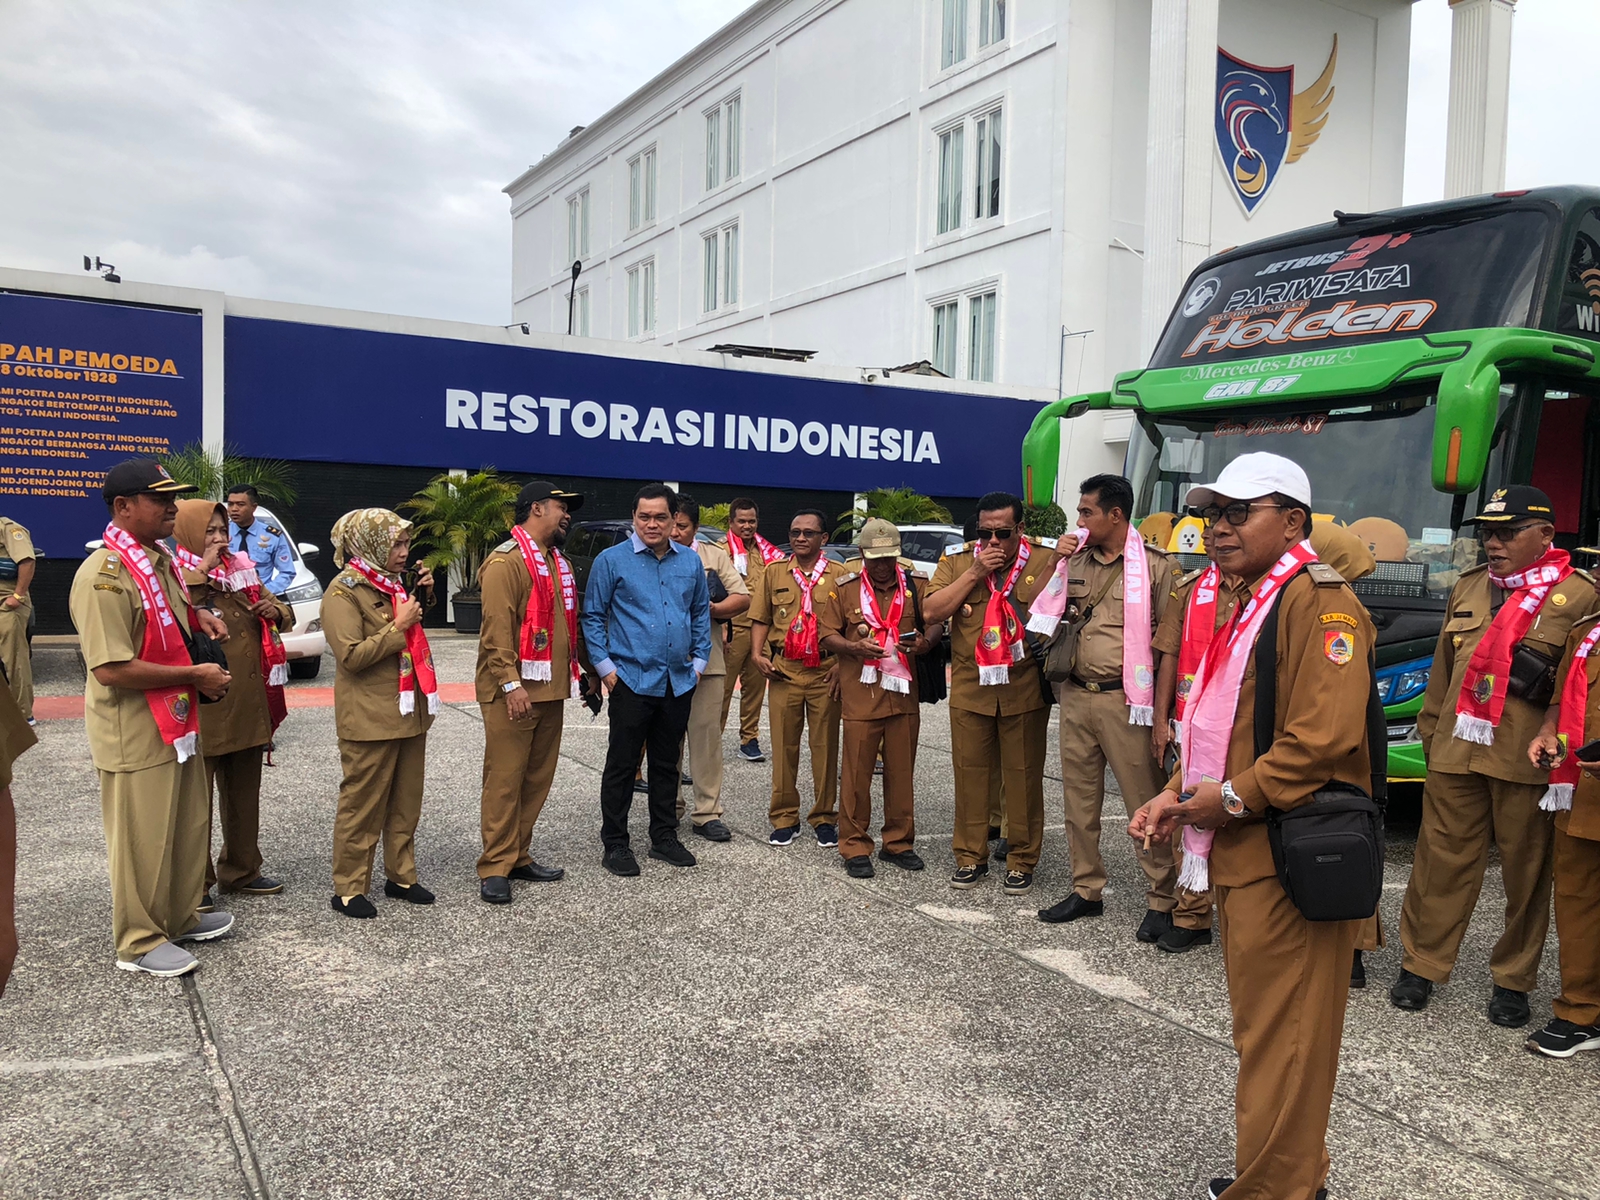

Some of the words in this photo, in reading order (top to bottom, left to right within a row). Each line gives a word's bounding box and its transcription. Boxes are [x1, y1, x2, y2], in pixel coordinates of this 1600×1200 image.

[1255, 250, 1345, 277] JETBUS
[1223, 264, 1410, 313] PARIWISATA
[1181, 299, 1438, 359] Holden
[59, 348, 178, 375] PEMOEDA
[14, 365, 81, 380] Oktober
[84, 370, 118, 384] 1928
[1257, 373, 1303, 395] 87
[0, 387, 14, 395] MI
[15, 388, 56, 398] POETRA
[57, 391, 80, 400] DAN
[81, 393, 116, 403] POETRI
[117, 396, 173, 409] INDONESIA,
[0, 397, 45, 407] NGAKOE
[46, 400, 113, 412] BERTOEMPAH
[115, 405, 149, 415] DARAH
[151, 408, 178, 418] JANG
[25, 408, 61, 418] TANAH
[62, 411, 120, 423] INDONESIA.
[1302, 414, 1328, 433] 87
[15, 427, 56, 438] POETRA
[57, 430, 80, 439] DAN
[81, 432, 116, 441] POETRI
[117, 434, 170, 445] INDONESIA
[446, 388, 715, 448] RESTORASI
[724, 413, 941, 465] INDONESIA
[0, 437, 45, 447] NGAKOE
[46, 439, 107, 451] BERBANGSA
[108, 443, 136, 452] JANG
[31, 448, 90, 459] INDONESIA.
[15, 467, 56, 476] POETRA
[57, 469, 80, 478] DAN
[81, 470, 109, 479] POET
[31, 488, 89, 498] INDONESIA.
